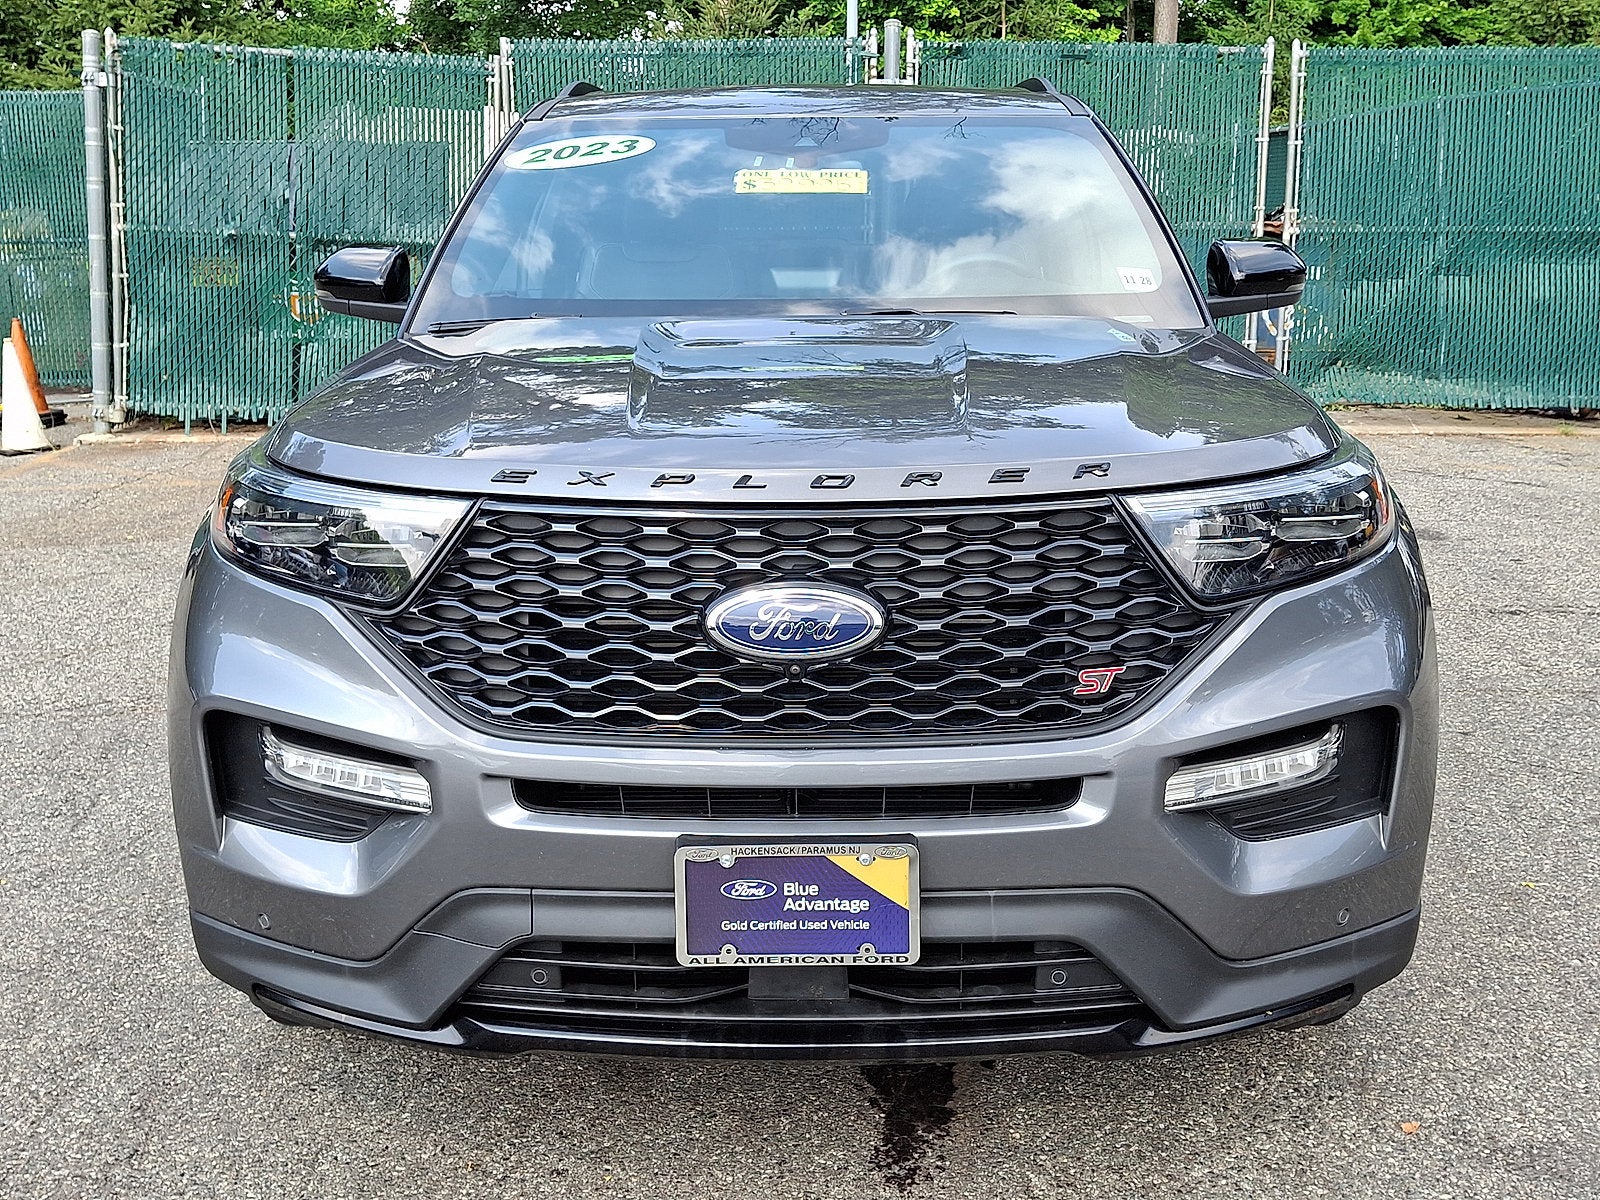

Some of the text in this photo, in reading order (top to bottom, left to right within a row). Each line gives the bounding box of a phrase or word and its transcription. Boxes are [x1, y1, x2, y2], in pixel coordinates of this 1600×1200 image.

[521, 139, 639, 165] 2023
[490, 462, 1112, 489] EXPLORER
[749, 603, 842, 641] Ford
[1073, 666, 1126, 695] ST
[848, 845, 861, 855] NJ
[730, 882, 766, 897] Ford
[783, 882, 819, 896] Blue
[783, 898, 870, 914] Advantage
[721, 919, 870, 931] Gold Certified Used Vehicle
[688, 955, 909, 965] ALL AMERICAN FORD
